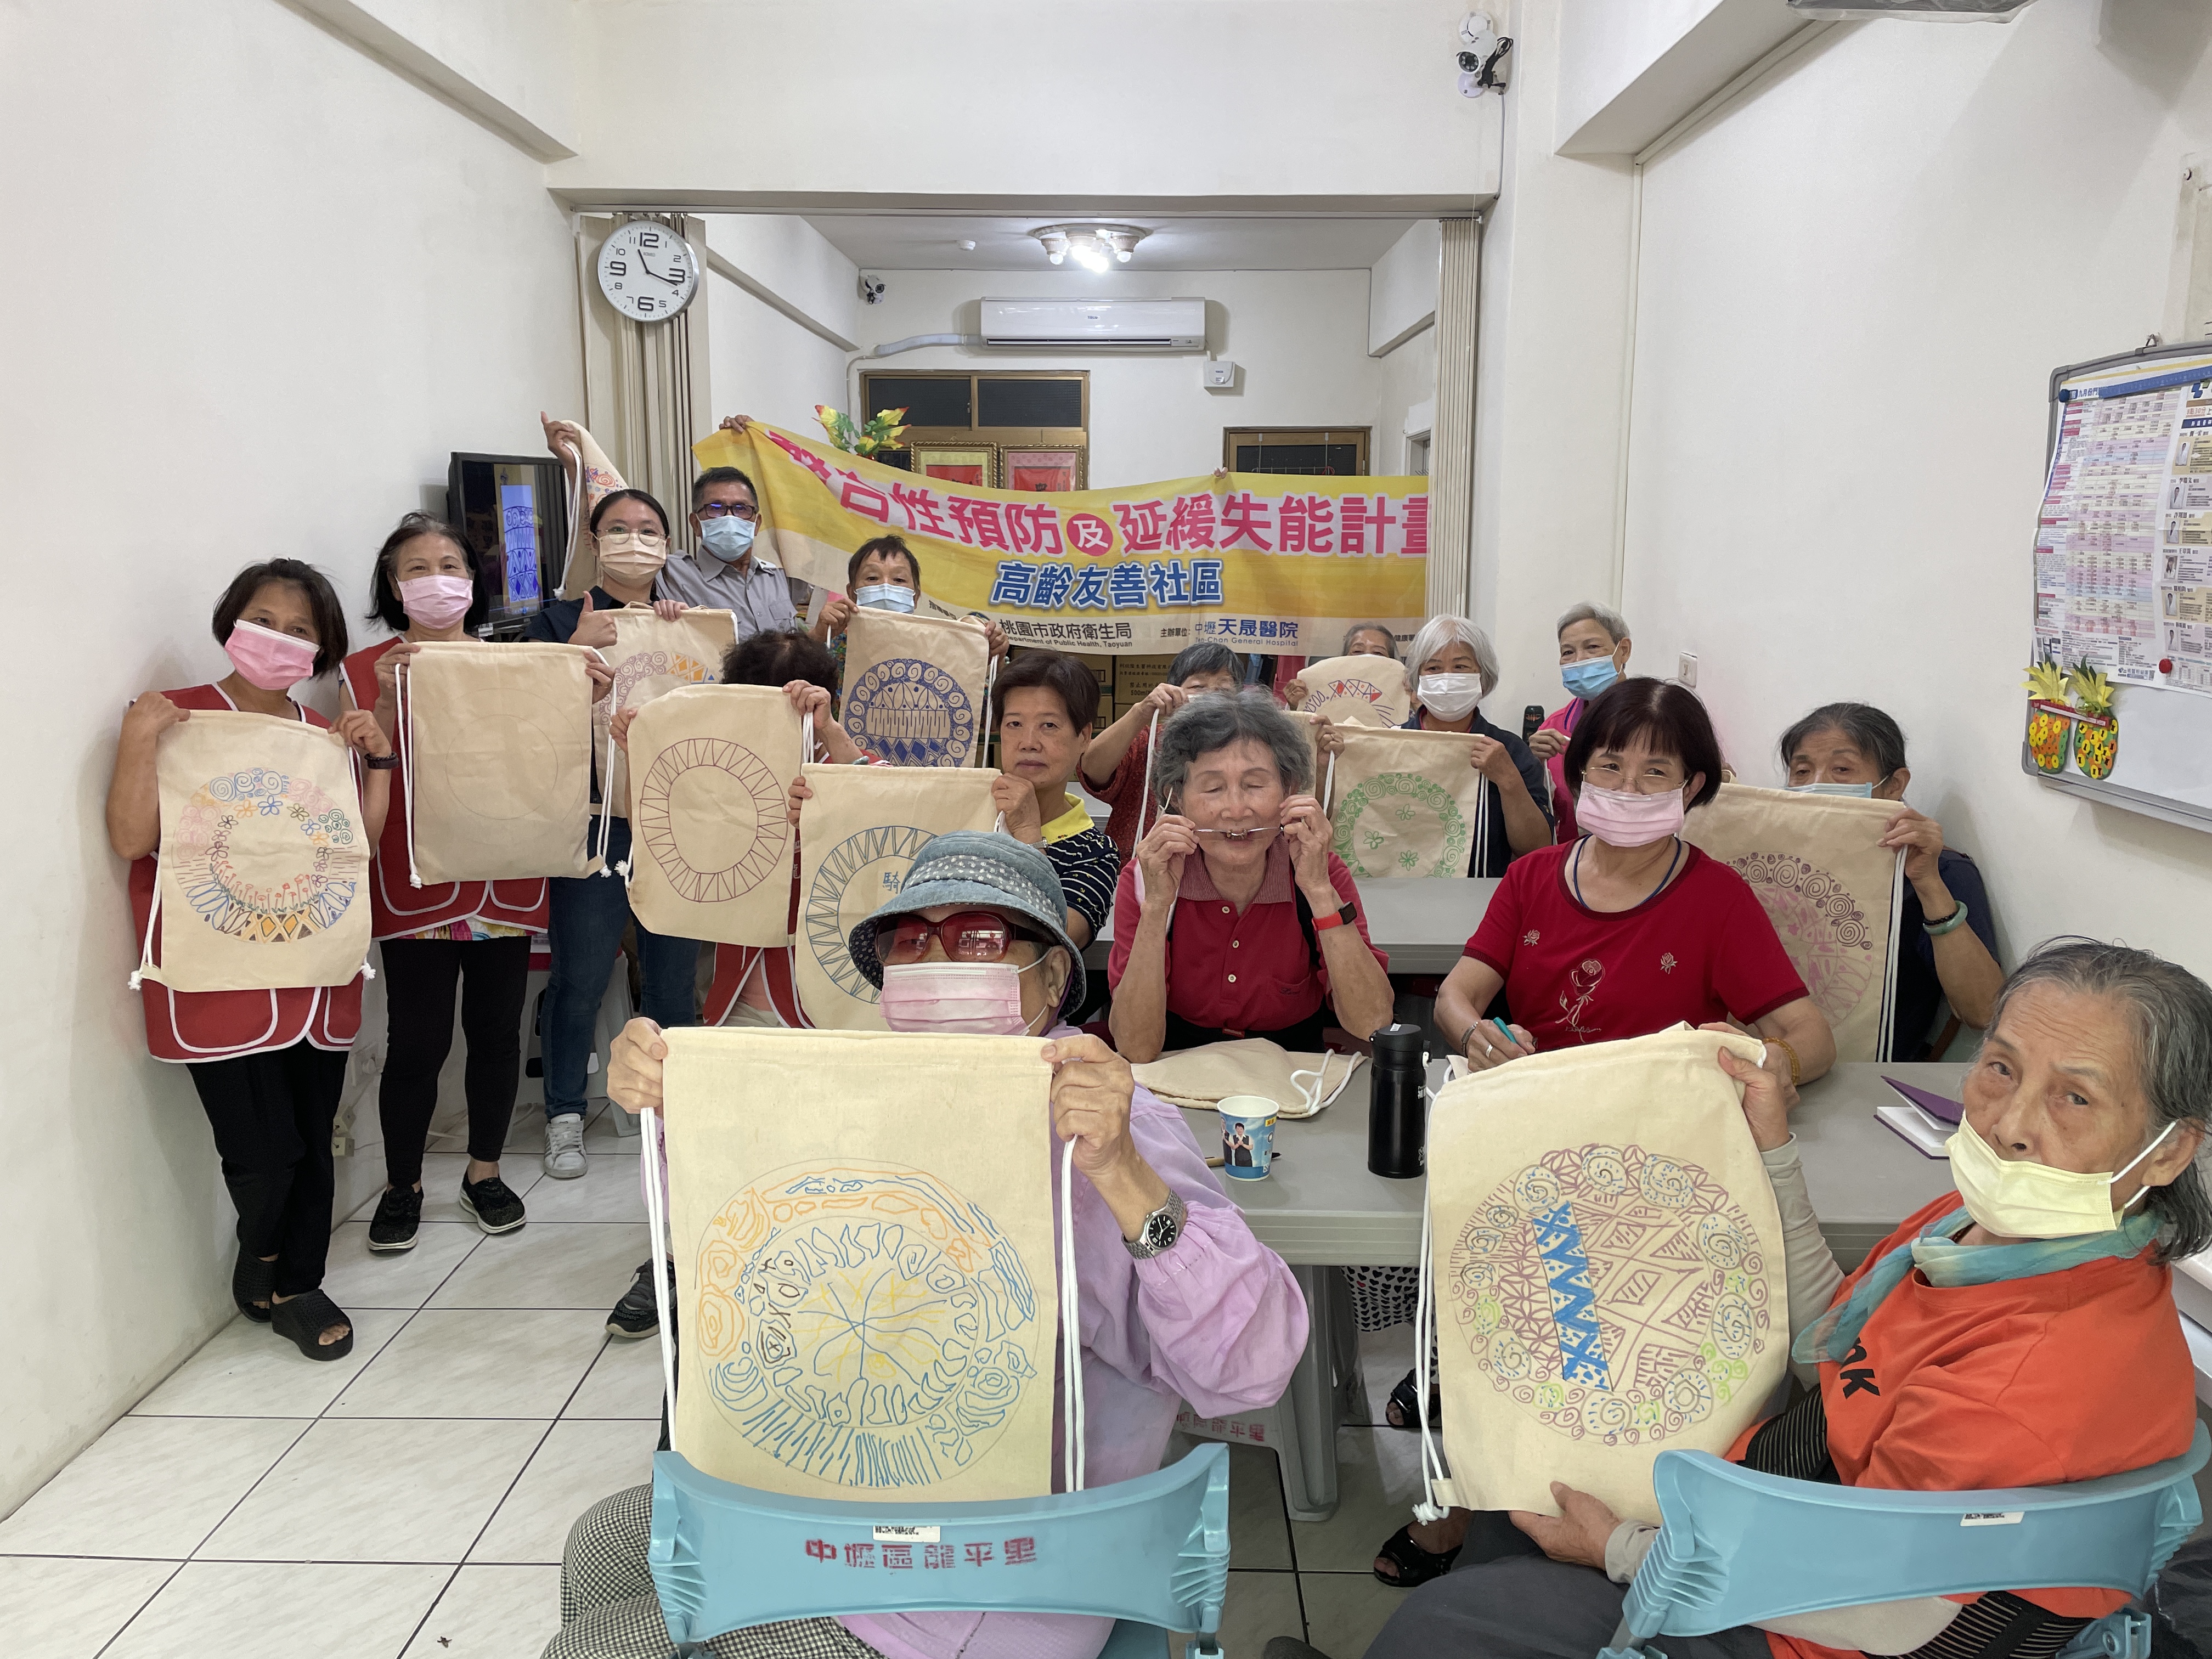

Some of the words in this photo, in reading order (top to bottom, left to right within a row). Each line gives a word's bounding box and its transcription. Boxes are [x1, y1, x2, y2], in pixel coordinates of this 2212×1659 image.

[639, 232, 659, 248] 12
[616, 247, 626, 256] 10
[673, 255, 681, 263] 2
[610, 261, 627, 276] 9
[669, 268, 686, 283] 3
[626, 296, 634, 304] 7
[637, 296, 654, 312] 6
[992, 558, 1224, 607] 高齡友善社區
[999, 619, 1132, 639] 桃園市政府衛生局
